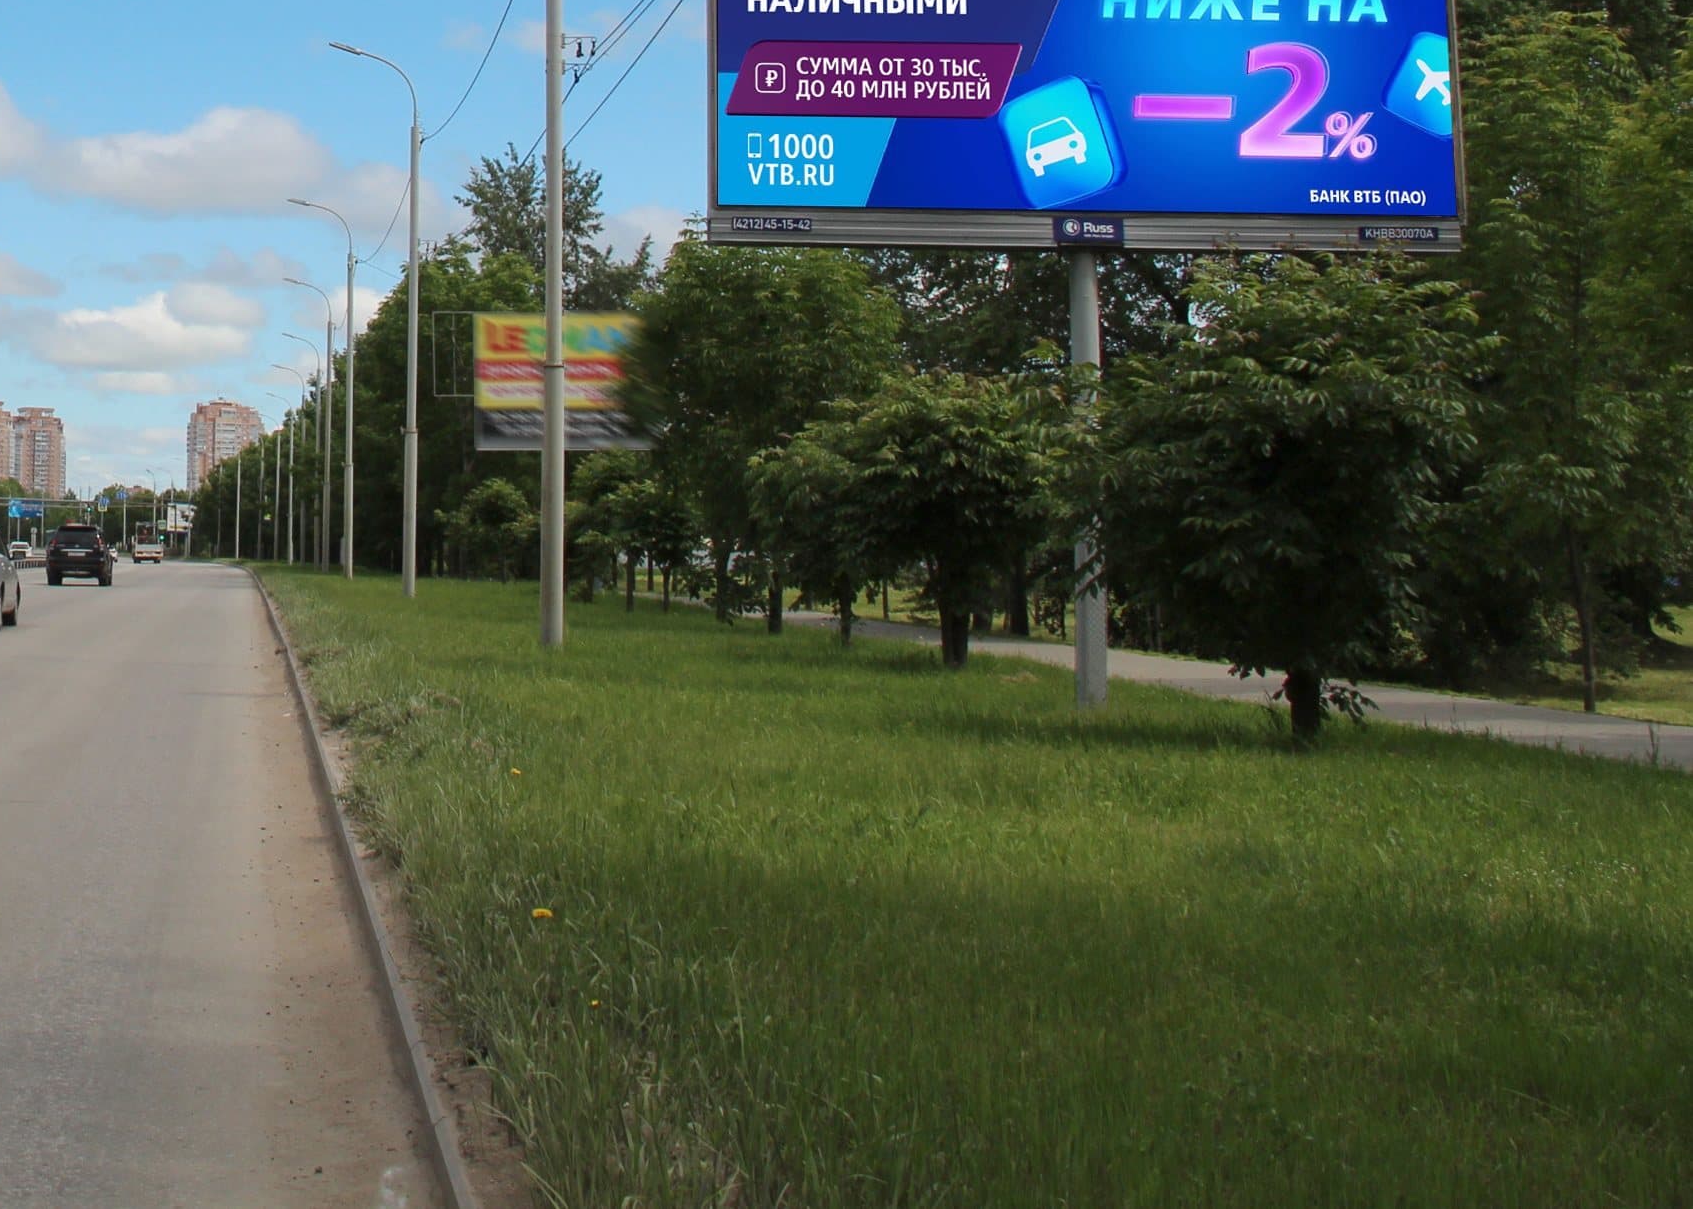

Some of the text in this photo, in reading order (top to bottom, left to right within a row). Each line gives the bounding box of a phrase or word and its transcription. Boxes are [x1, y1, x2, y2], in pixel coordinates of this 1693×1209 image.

[795, 57, 987, 77] СУММА ОТ 30 ТЫС.
[795, 77, 991, 100] ДО 40 МЛН РУБЛЕЙ
[768, 134, 834, 159] 1000
[748, 163, 835, 186] VTB.RU
[1310, 190, 1426, 206] БАНК ВТБ (ПАО)
[1083, 222, 1115, 233] Russ
